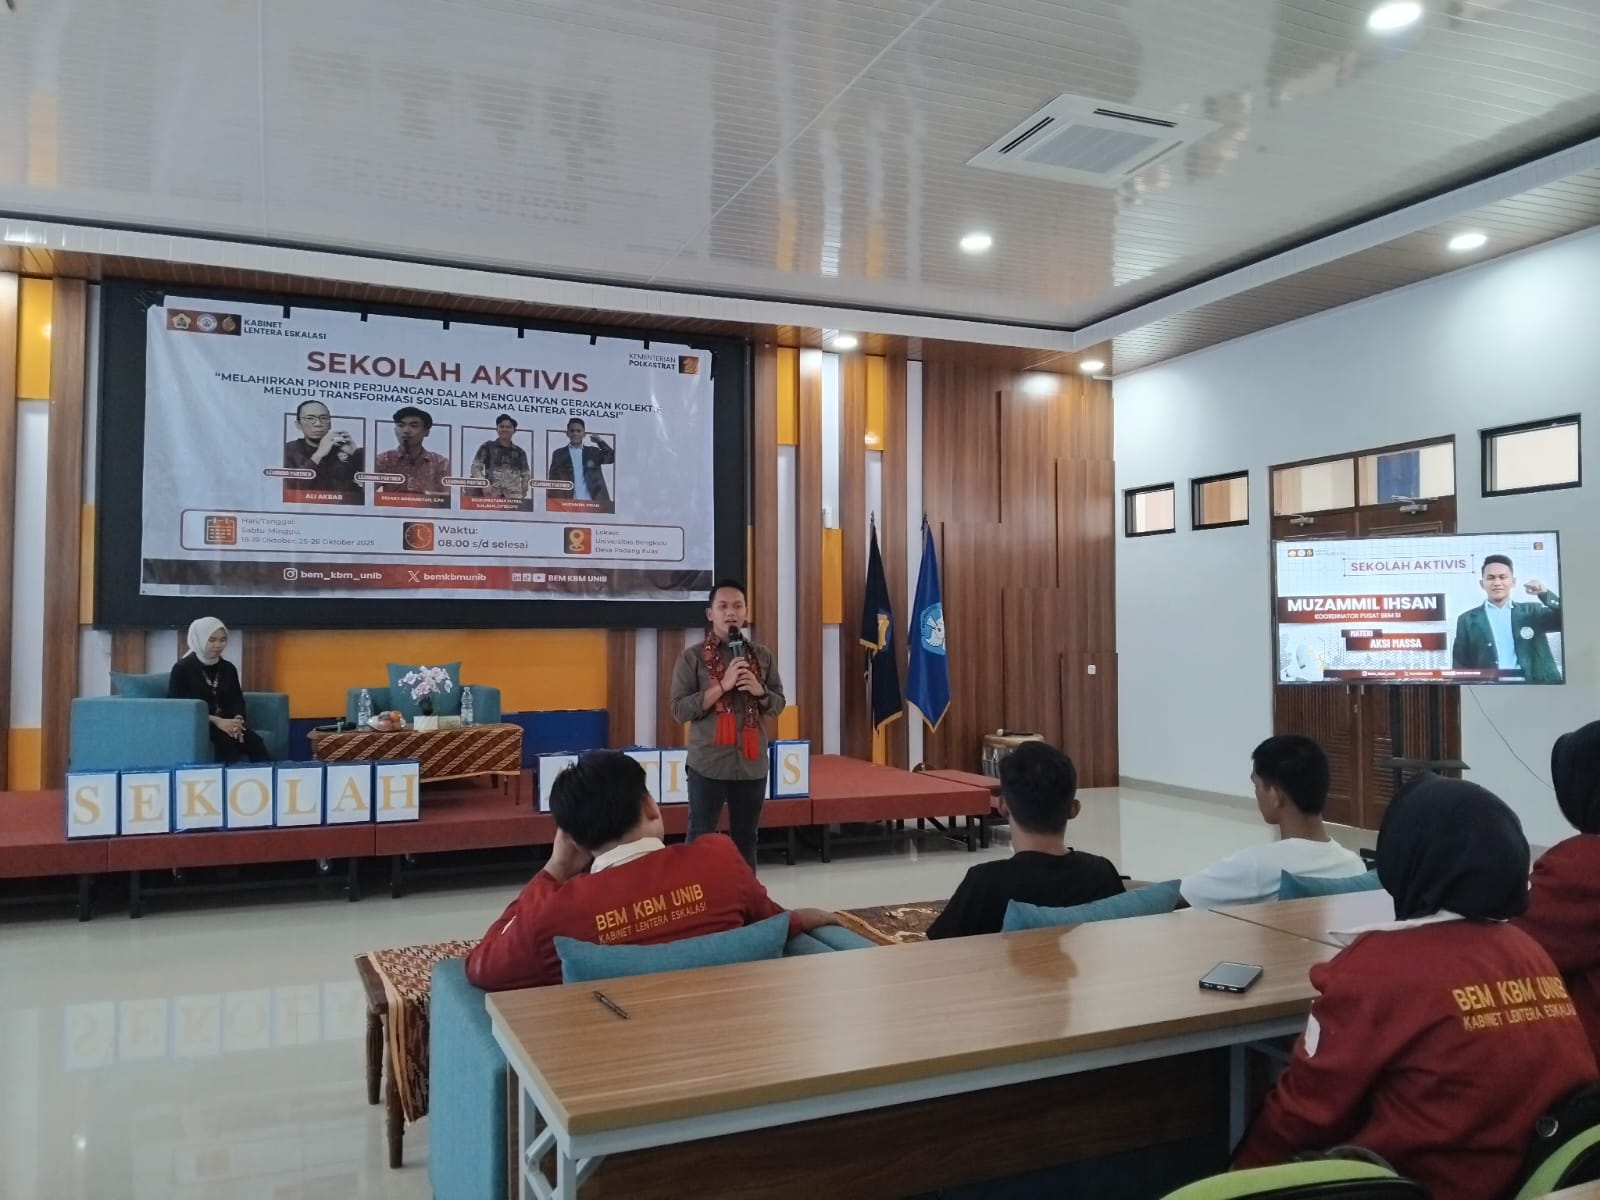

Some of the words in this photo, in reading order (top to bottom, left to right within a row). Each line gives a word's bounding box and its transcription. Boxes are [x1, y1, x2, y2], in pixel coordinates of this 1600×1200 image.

[243, 319, 283, 329] KABINET
[243, 327, 282, 337] LENTERA
[284, 330, 327, 340] ESKALASI
[629, 353, 676, 363] KEMENTERIAN
[629, 359, 676, 370] POLKASTRAT
[307, 351, 461, 382] SEKOLAH
[471, 365, 589, 393] AKTIVIS
[308, 379, 350, 390] PIONIR
[353, 382, 434, 397] PERJUANGAN
[437, 388, 478, 400] DALAM
[481, 392, 558, 406] MENGUATKAN
[561, 398, 612, 409] GERAKAN
[263, 386, 316, 397] MENUJU
[319, 389, 413, 404] TRANSFORMASI
[416, 396, 457, 407] SOSIAL
[460, 399, 515, 412] BERSAMA
[518, 404, 567, 415] LENTERA
[438, 526, 478, 536] Waktu:
[323, 538, 354, 546] Oktober
[438, 539, 470, 549] 08.00
[472, 539, 491, 550] s/d
[492, 540, 529, 551] selesai
[1351, 561, 1410, 572] SEKOLAH
[1414, 559, 1466, 570] AKTIVIS
[300, 570, 383, 581] bem_kbm_unib
[423, 572, 487, 582] bemkbmunib
[548, 574, 566, 582] BEM
[1287, 598, 1380, 612] MUZAMMIL
[1383, 596, 1437, 610] IHSAN
[1350, 630, 1373, 638] MATERI
[1370, 638, 1391, 649] AKSI
[1392, 638, 1422, 649] MASSA
[73, 774, 418, 825] SEKOLAH
[595, 906, 628, 931] BEM
[633, 894, 667, 919] KBM
[671, 884, 704, 906] UNIB
[599, 925, 632, 944] KABINET
[635, 914, 669, 932] LENTERA
[671, 901, 707, 920] ESKALASI
[1452, 984, 1495, 1011] BEM
[1497, 977, 1537, 1005] KBM
[1463, 1012, 1503, 1031] KABINET
[1505, 1006, 1544, 1023] LENTERA
